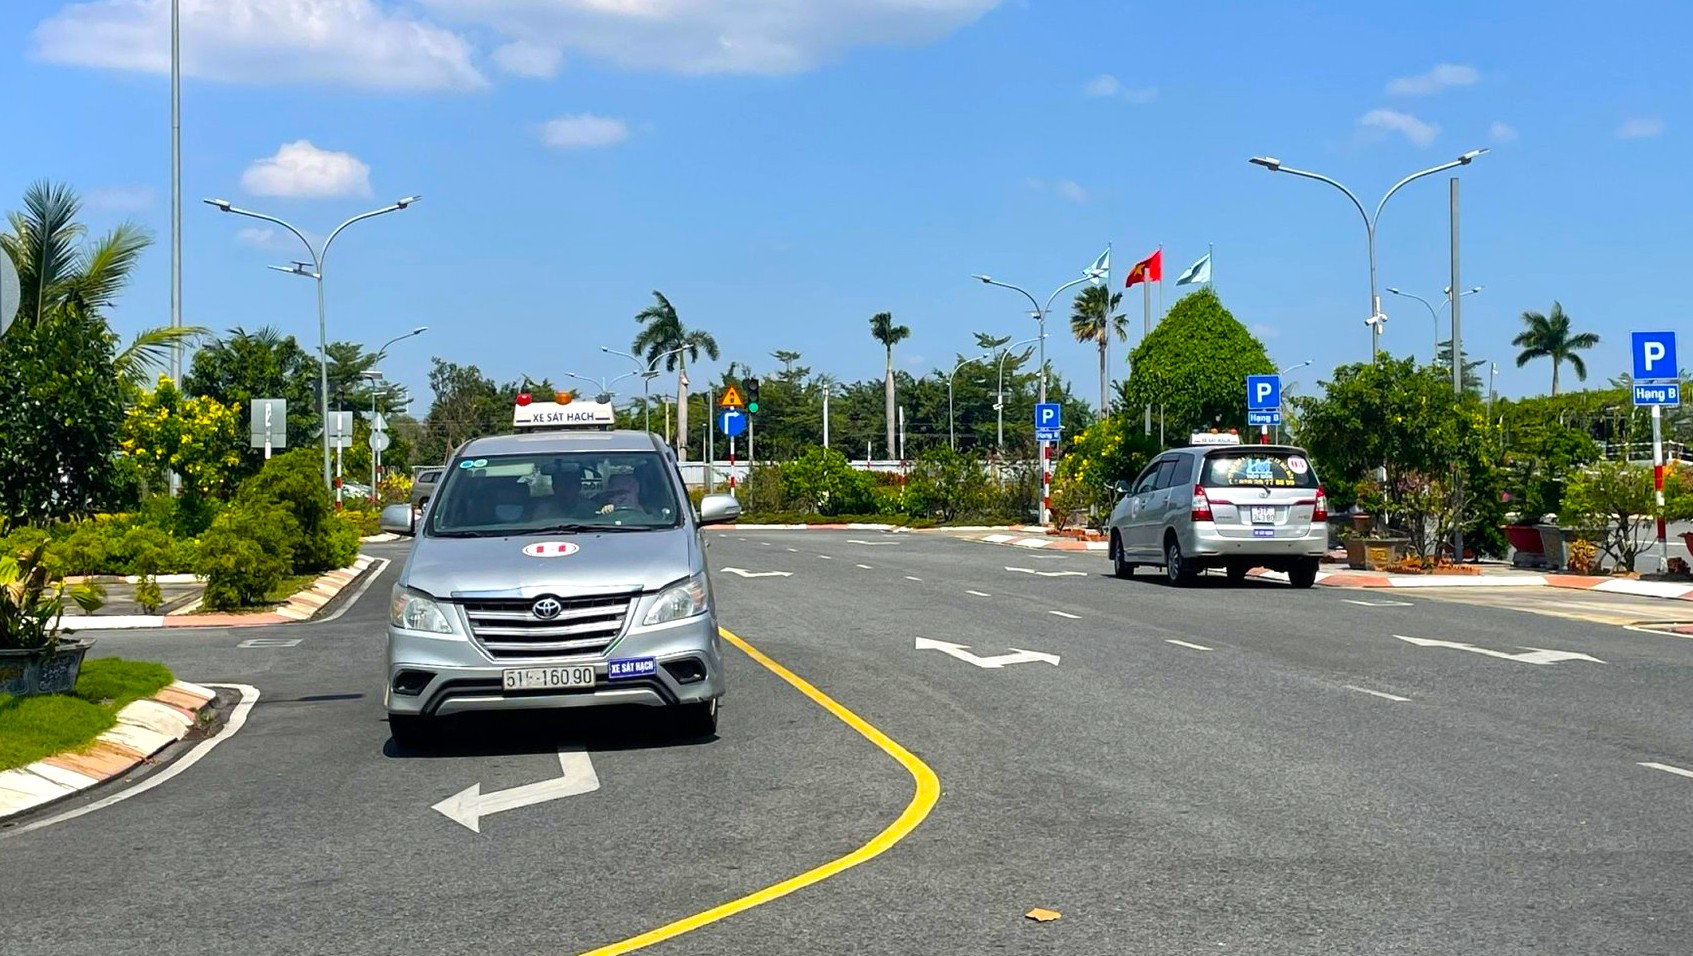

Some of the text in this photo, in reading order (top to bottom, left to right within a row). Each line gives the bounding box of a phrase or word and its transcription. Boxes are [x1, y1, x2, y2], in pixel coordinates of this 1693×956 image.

[1644, 341, 1666, 371] P
[1257, 382, 1272, 403] P
[1636, 387, 1676, 402] Hạng B
[533, 411, 594, 422] XE SÁT HẠCH
[1042, 408, 1054, 424] P
[611, 660, 654, 674] XE SÁT HẠCH
